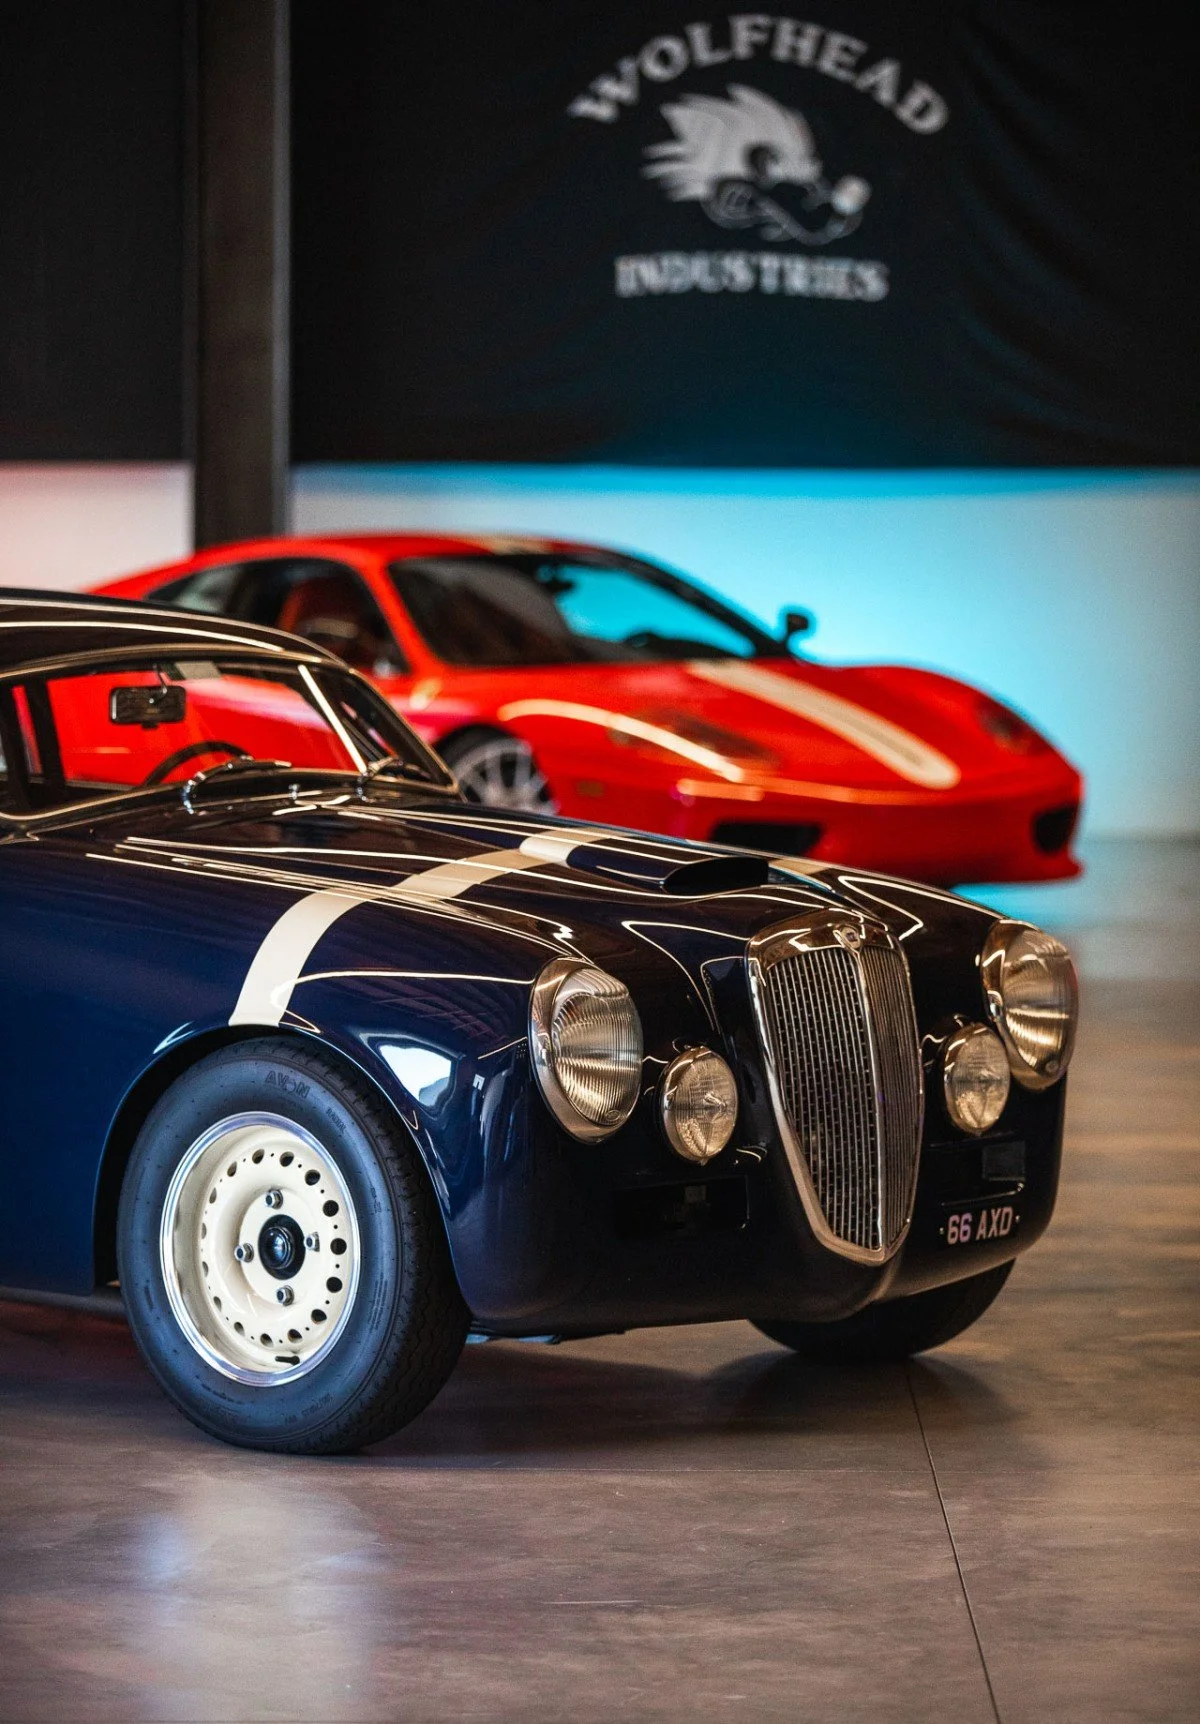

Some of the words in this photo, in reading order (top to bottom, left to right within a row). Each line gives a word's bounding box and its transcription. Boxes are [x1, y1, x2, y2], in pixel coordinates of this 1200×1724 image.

[569, 15, 948, 133] WOLFHEAD
[615, 251, 889, 301] INDUSTRIES
[265, 1071, 310, 1098] AVON
[947, 1213, 973, 1245] 66
[975, 1206, 1014, 1240] AXD
